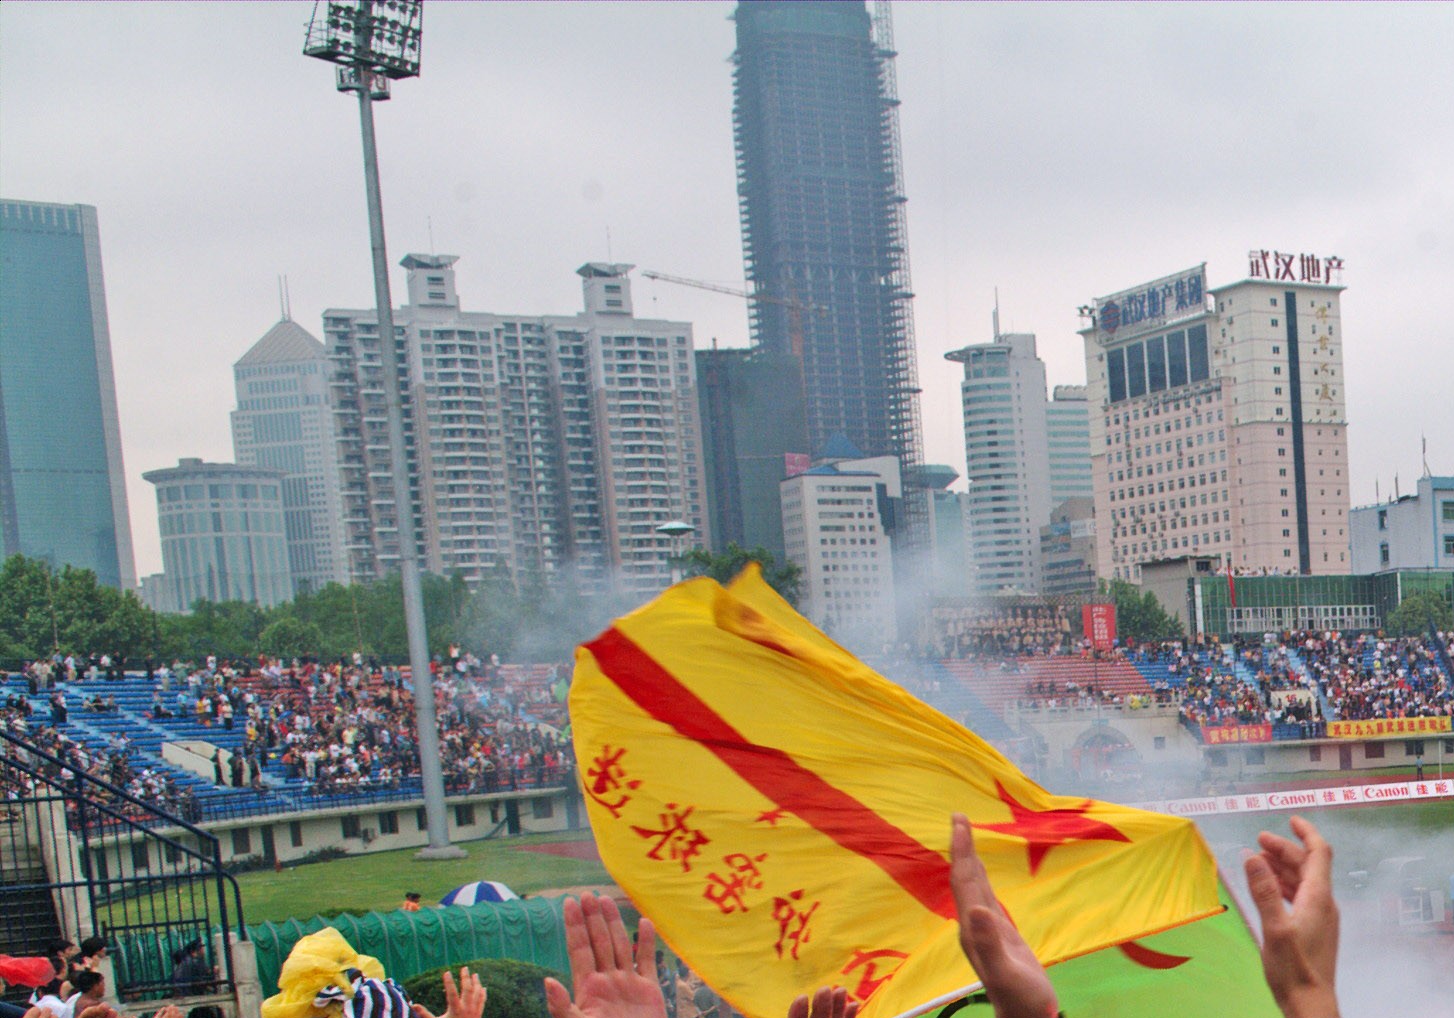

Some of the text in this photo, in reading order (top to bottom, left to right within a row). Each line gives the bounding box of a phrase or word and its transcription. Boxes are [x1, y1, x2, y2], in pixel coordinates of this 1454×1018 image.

[1249, 249, 1345, 284] 武汉地产
[1167, 801, 1217, 814] Canon
[1268, 793, 1315, 806] Canon
[1322, 789, 1357, 802] 佳能
[1364, 785, 1409, 799] Canon
[1416, 782, 1448, 796] 佳能
